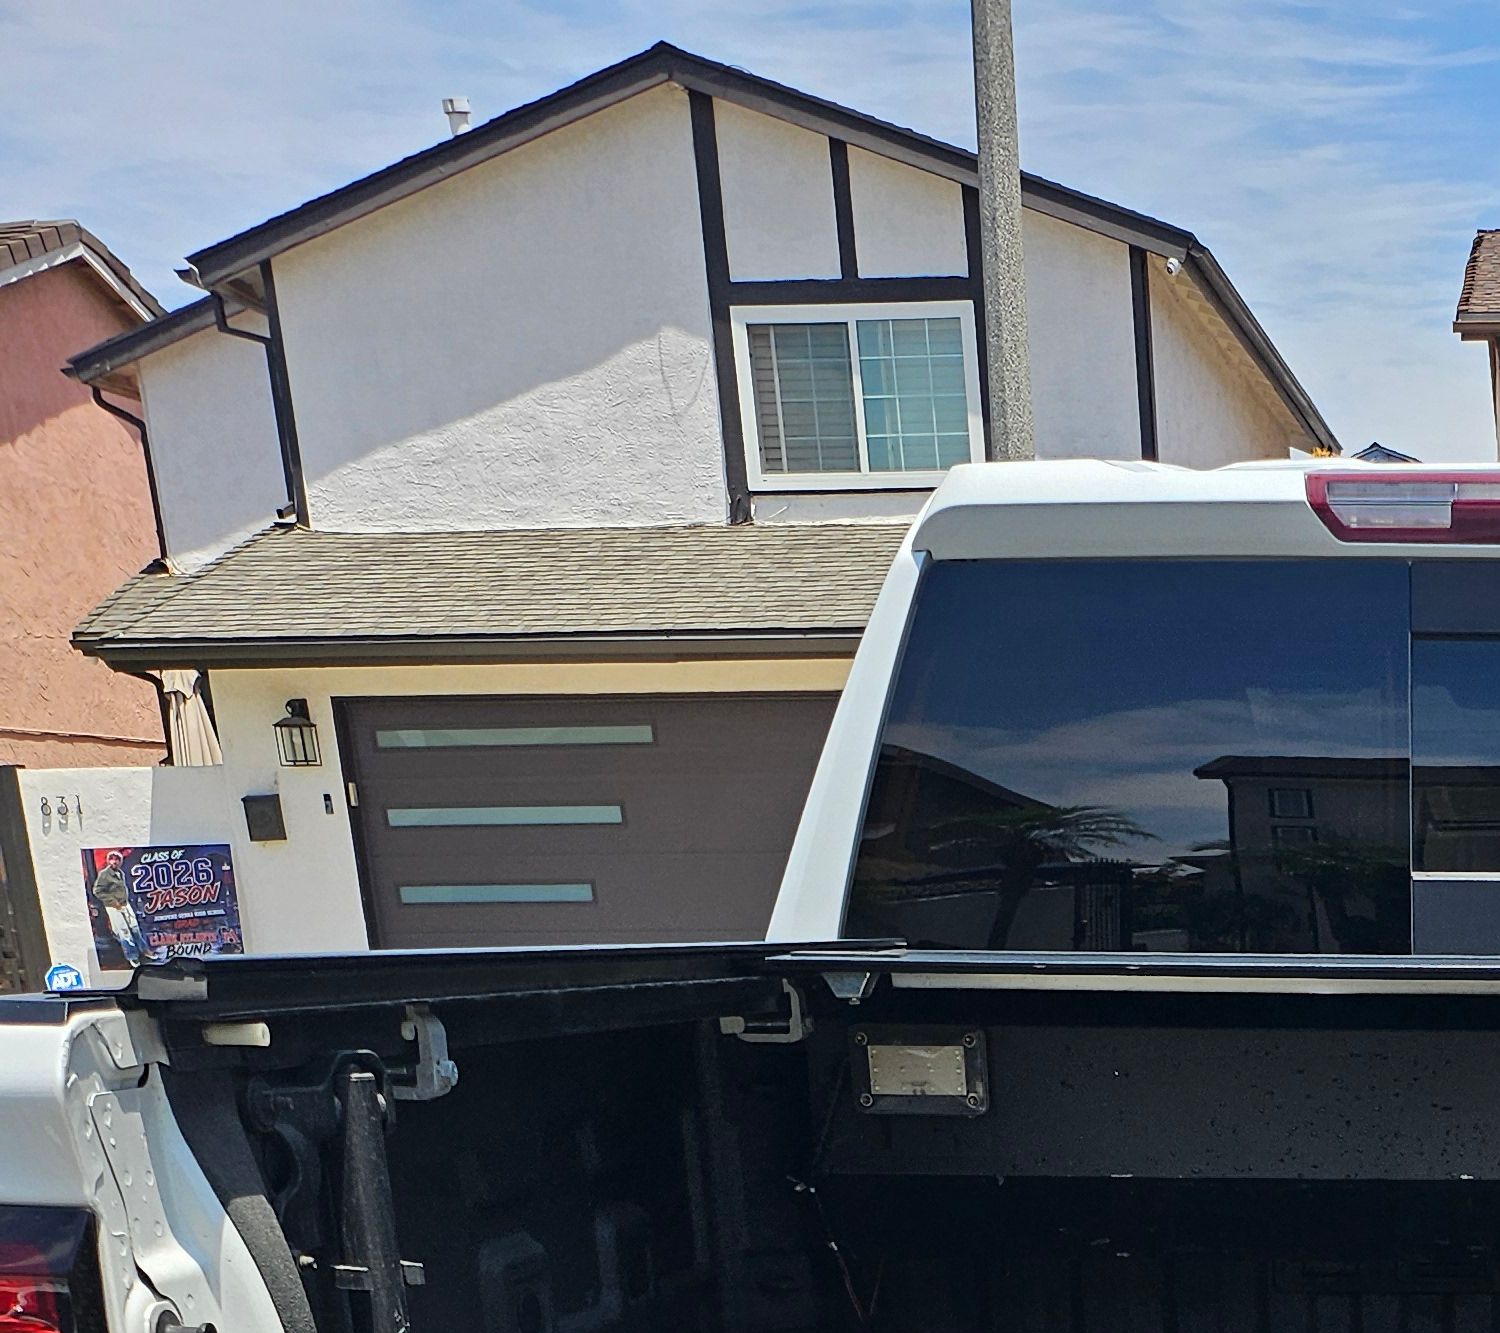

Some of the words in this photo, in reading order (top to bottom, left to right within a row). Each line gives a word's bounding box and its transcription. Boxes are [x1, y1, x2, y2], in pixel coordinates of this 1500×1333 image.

[41, 795, 82, 815] 831
[141, 851, 170, 864] CLASS
[171, 849, 186, 860] OF
[131, 857, 214, 893] 2026
[144, 881, 221, 914] JASON
[166, 943, 212, 959] BOUND
[52, 972, 79, 990] ADT
